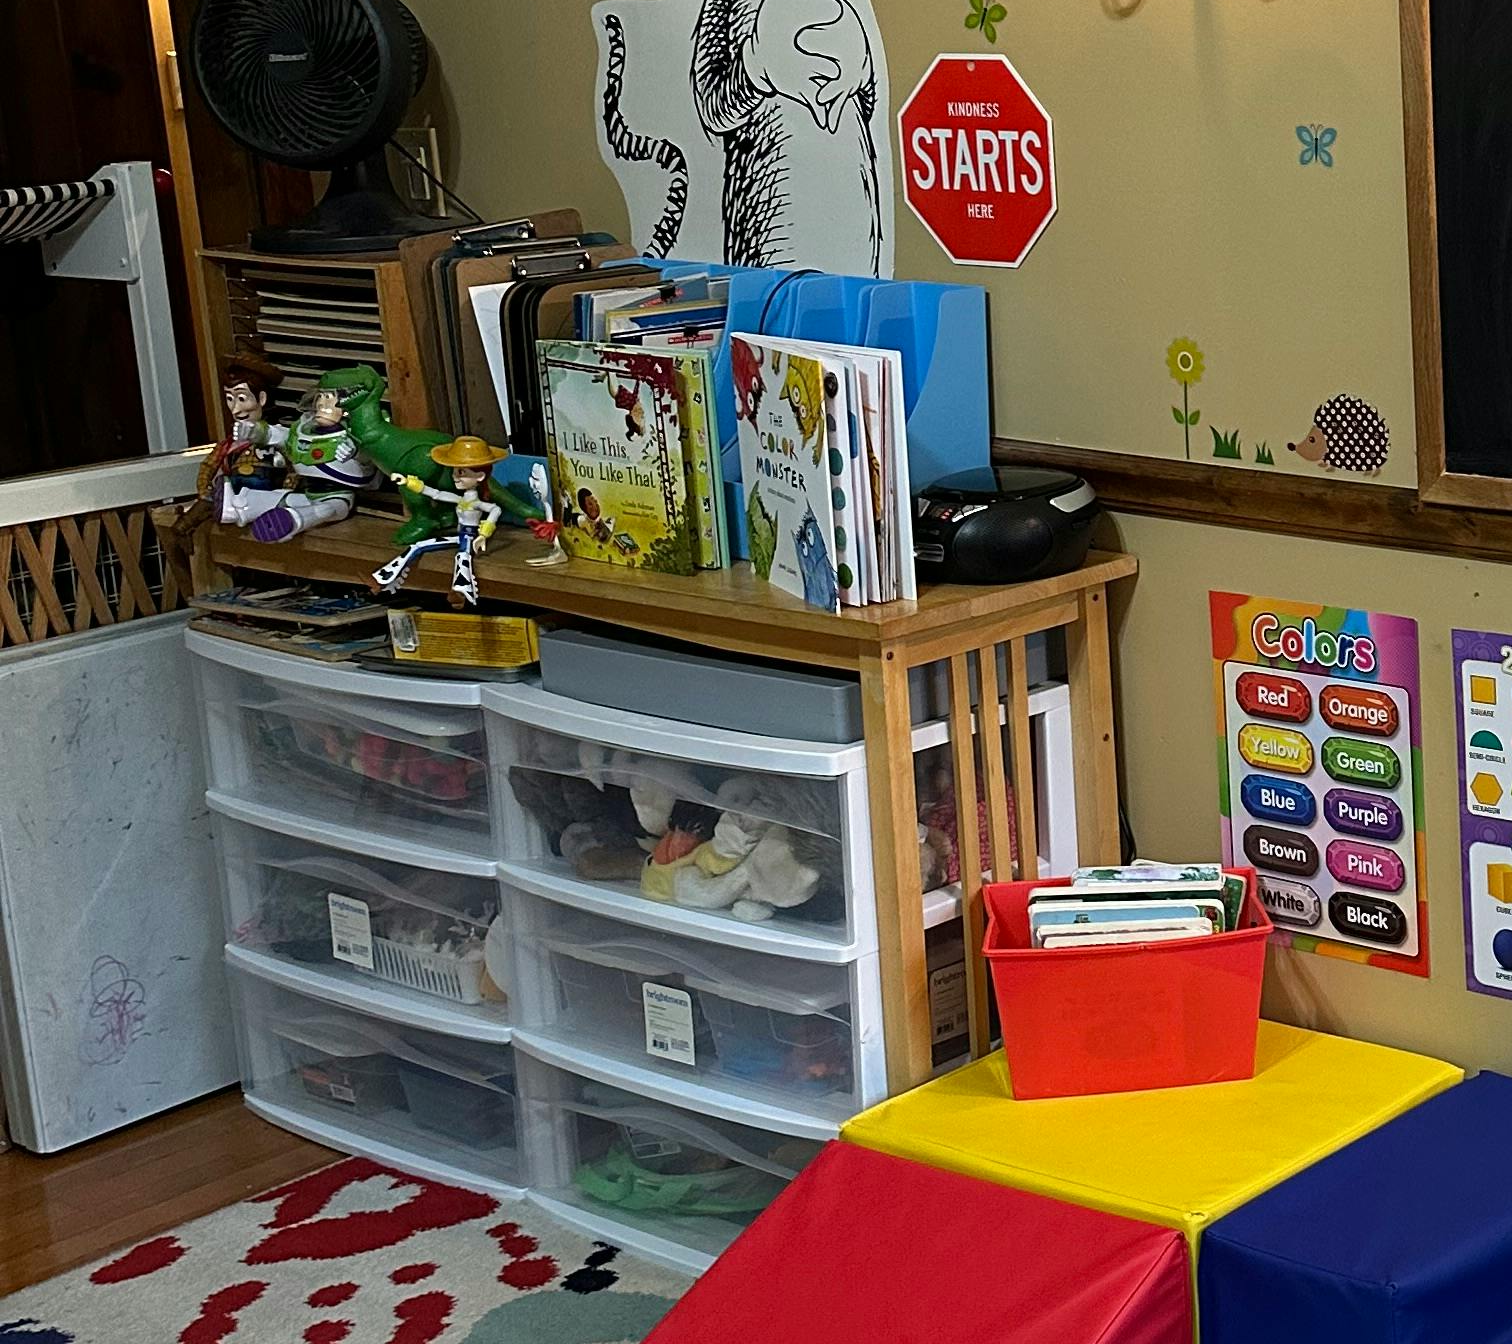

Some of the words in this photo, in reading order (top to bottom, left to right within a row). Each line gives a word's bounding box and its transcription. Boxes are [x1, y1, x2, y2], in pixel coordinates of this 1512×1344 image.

[948, 103, 999, 118] KINDNESS
[912, 127, 1044, 195] STARTS
[968, 204, 994, 219] HERE
[563, 432, 568, 450] I
[573, 433, 596, 454] Like
[760, 432, 798, 461] COLOR
[570, 458, 594, 479] You
[599, 462, 623, 483] Like
[626, 466, 656, 488] That
[756, 456, 806, 492] MONSTER
[1252, 613, 1375, 673] Colors
[1258, 686, 1288, 707] Red
[1329, 699, 1388, 725] Orange
[1250, 736, 1299, 760] Yellow
[1337, 752, 1384, 775] Green
[1261, 788, 1295, 811] Blue
[1339, 801, 1388, 826] Purple
[1259, 839, 1307, 863] Brown
[1348, 856, 1383, 876] Pink
[1262, 888, 1304, 912] White
[1347, 906, 1388, 929] Black
